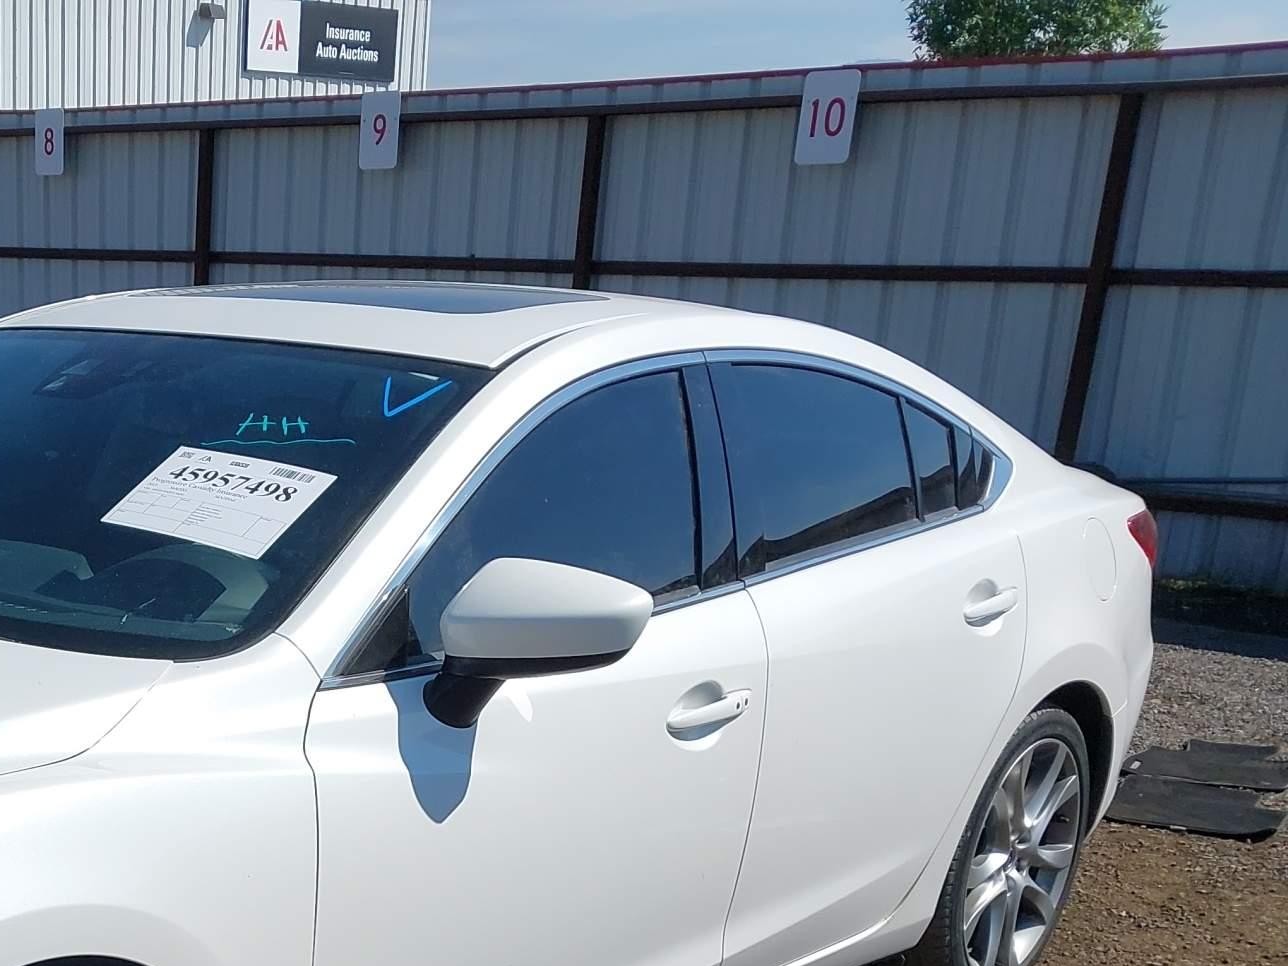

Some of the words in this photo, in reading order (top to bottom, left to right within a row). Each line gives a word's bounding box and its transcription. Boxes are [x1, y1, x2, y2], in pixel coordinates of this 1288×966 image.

[325, 22, 371, 42] Insurance
[315, 42, 338, 59] Auto
[339, 43, 379, 62] Auctions
[373, 113, 387, 146] 9
[809, 96, 846, 138] 10
[43, 127, 55, 156] 8
[169, 465, 298, 502] 45957498
